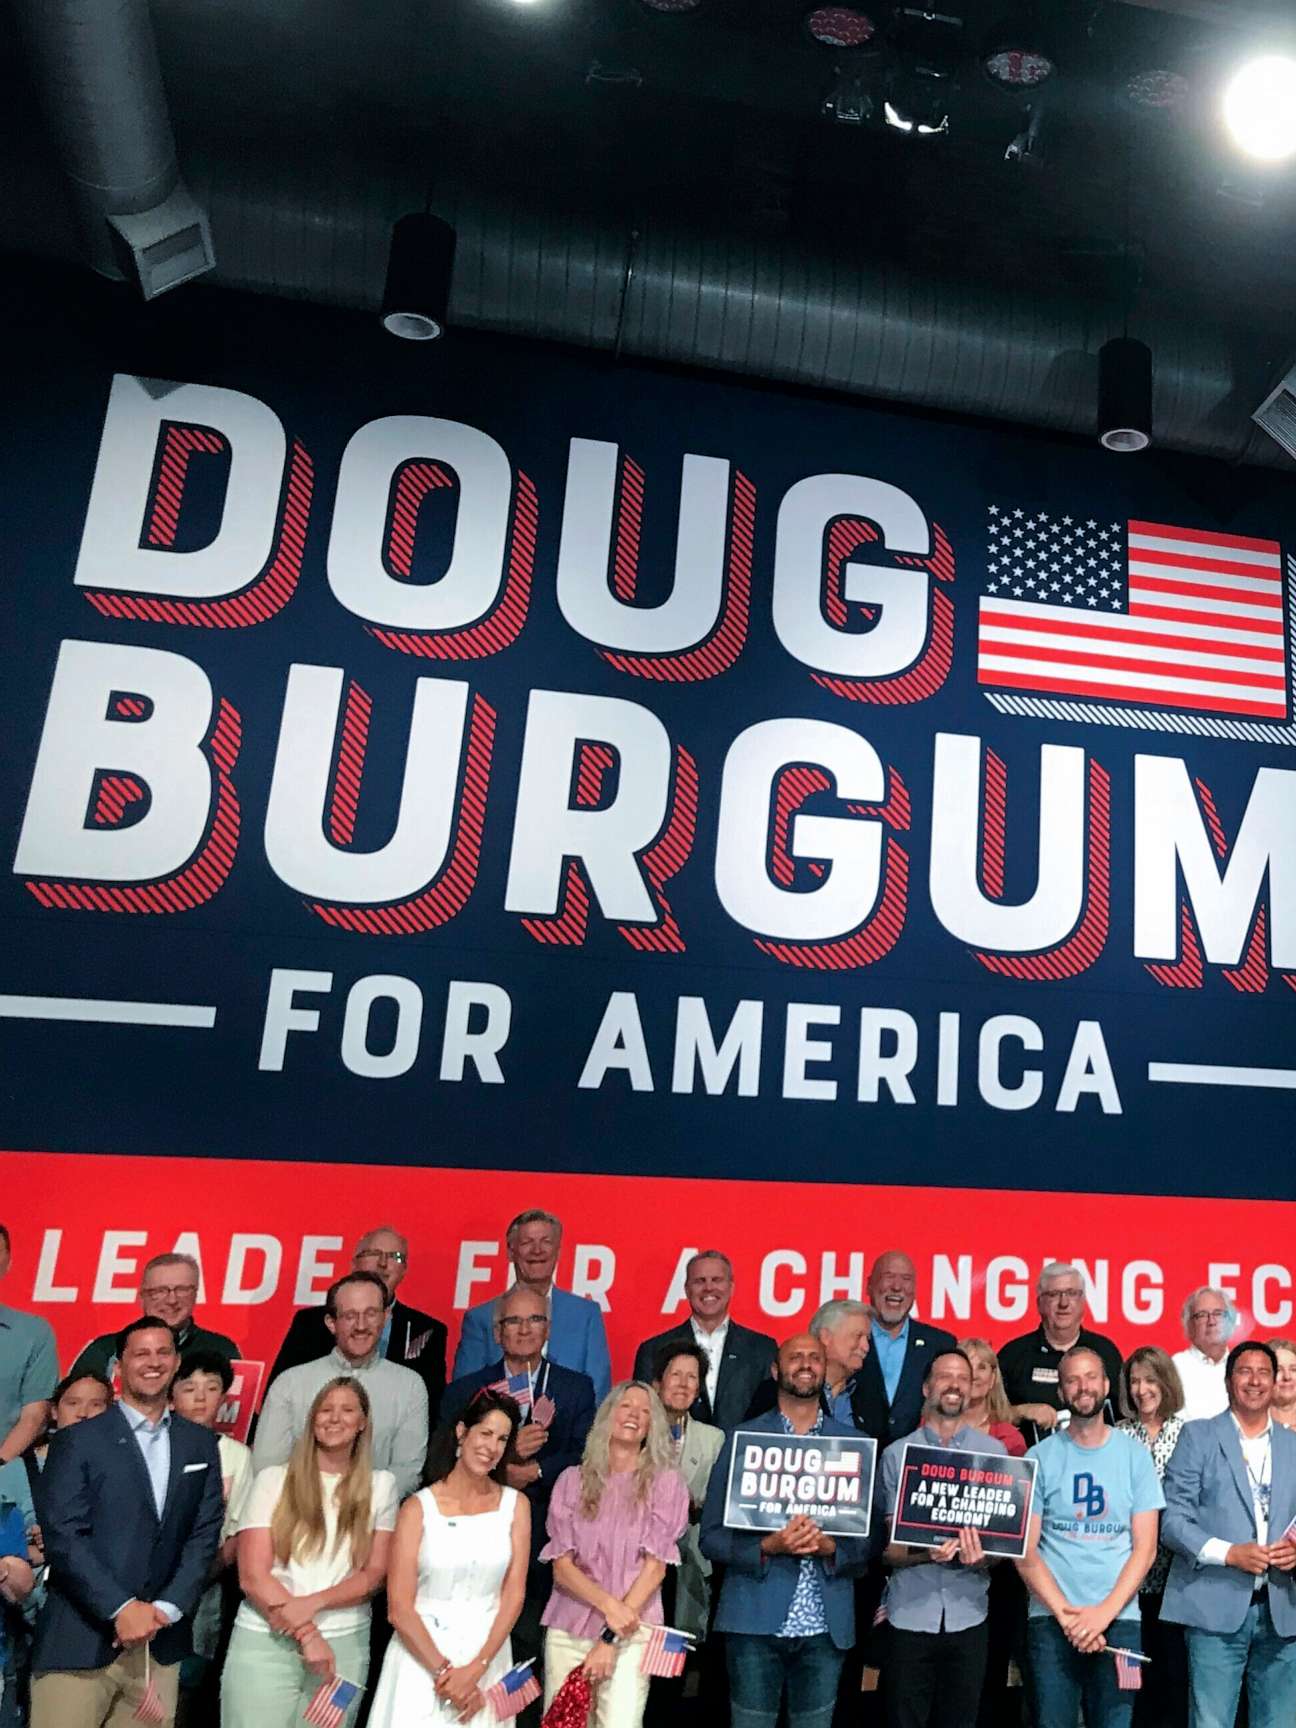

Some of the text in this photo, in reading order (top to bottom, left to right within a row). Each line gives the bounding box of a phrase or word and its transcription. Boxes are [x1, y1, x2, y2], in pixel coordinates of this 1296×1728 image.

[72, 371, 945, 692] DOUG
[257, 966, 1124, 1116] FOR AMERICA
[31, 1228, 346, 1307] LEADE
[452, 1239, 617, 1313] FR
[758, 1248, 1165, 1326] CHNGNG
[743, 1445, 823, 1474] DOUG
[740, 1471, 861, 1503] BURGUM
[921, 1463, 1015, 1486] DOUG BURGUM
[918, 1480, 1012, 1503] A NEW LEADER
[759, 1501, 782, 1514] FOR
[910, 1492, 1017, 1518] FOR A CHANGING
[930, 1508, 992, 1528] ECONOMY
[1084, 1522, 1123, 1535] BURGU
